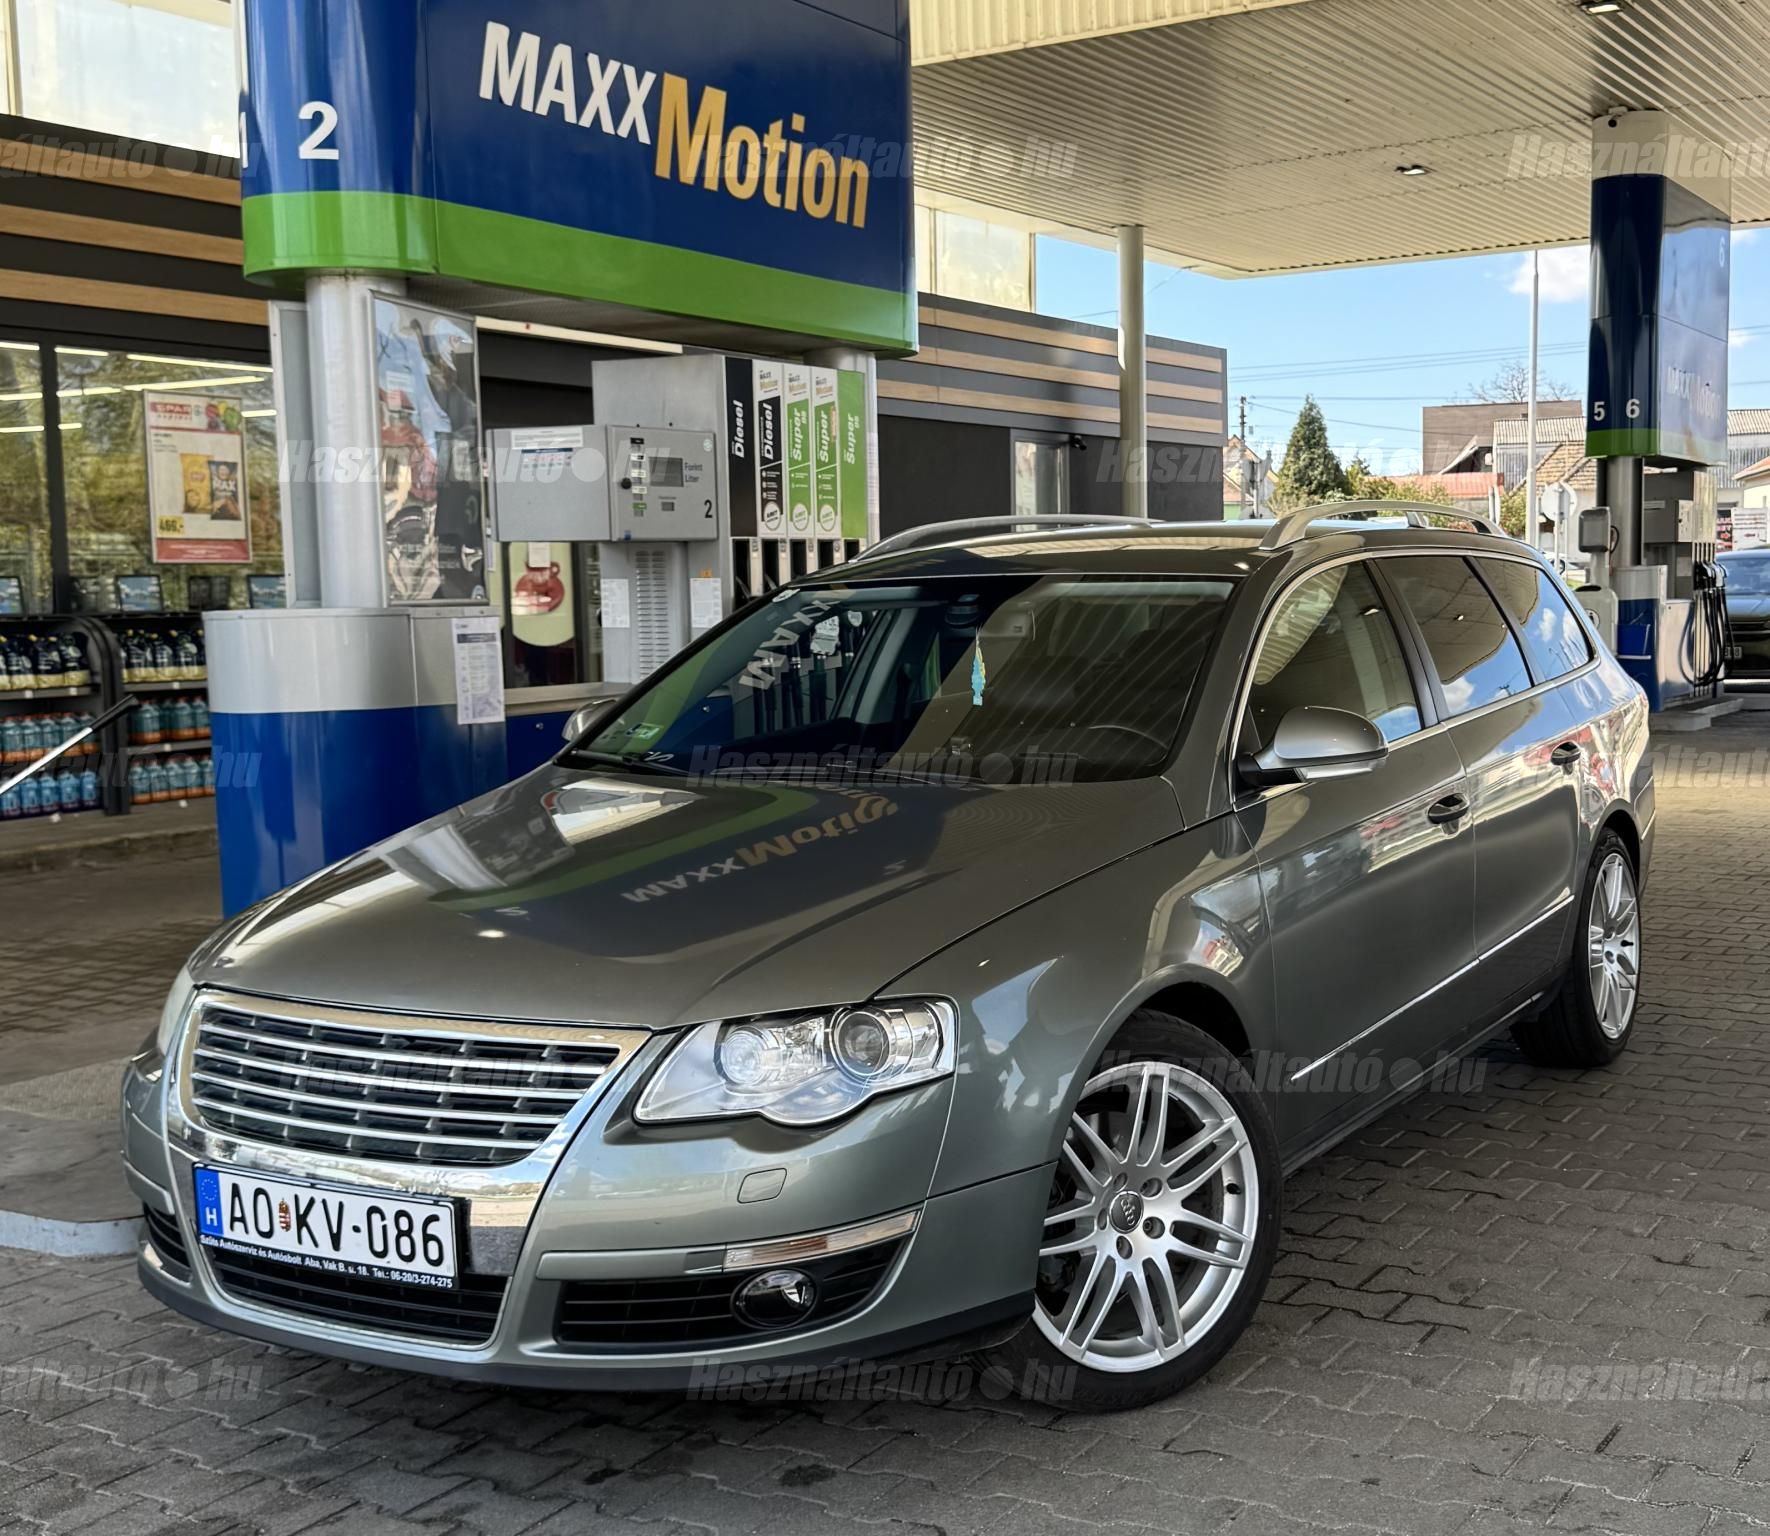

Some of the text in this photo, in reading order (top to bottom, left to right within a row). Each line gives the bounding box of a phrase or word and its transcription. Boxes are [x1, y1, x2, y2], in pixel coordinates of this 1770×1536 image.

[298, 101, 340, 160] 2
[733, 400, 744, 458] Diesel
[763, 403, 773, 460] Diesel
[793, 408, 803, 461] Super
[1593, 402, 1606, 421] 5
[1625, 399, 1641, 419] 6
[820, 410, 829, 463] Super
[846, 413, 856, 464] Super
[704, 500, 713, 518] 2
[205, 1207, 218, 1226] H
[229, 1182, 444, 1267] AO KV-086
[304, 1257, 322, 1269] Aba,
[323, 1260, 337, 1270] Vak
[339, 1262, 348, 1273] B.
[357, 1266, 369, 1276] 18.
